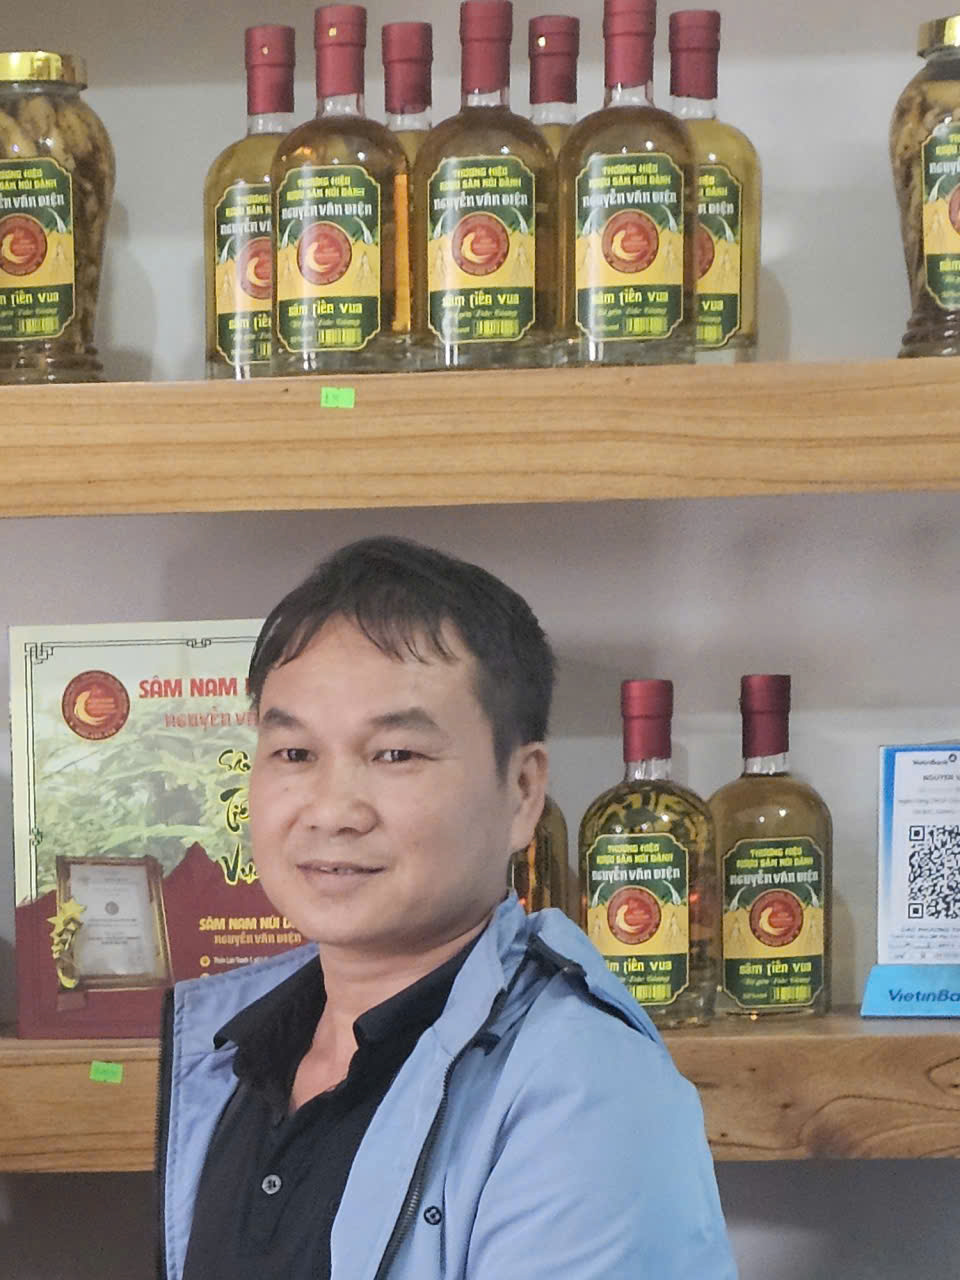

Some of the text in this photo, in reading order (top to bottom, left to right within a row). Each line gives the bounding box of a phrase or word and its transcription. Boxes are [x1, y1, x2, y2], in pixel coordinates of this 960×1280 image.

[138, 675, 238, 699] SÂM NAM
[228, 916, 258, 930] NAM
[887, 988, 960, 1003] VietinBa
